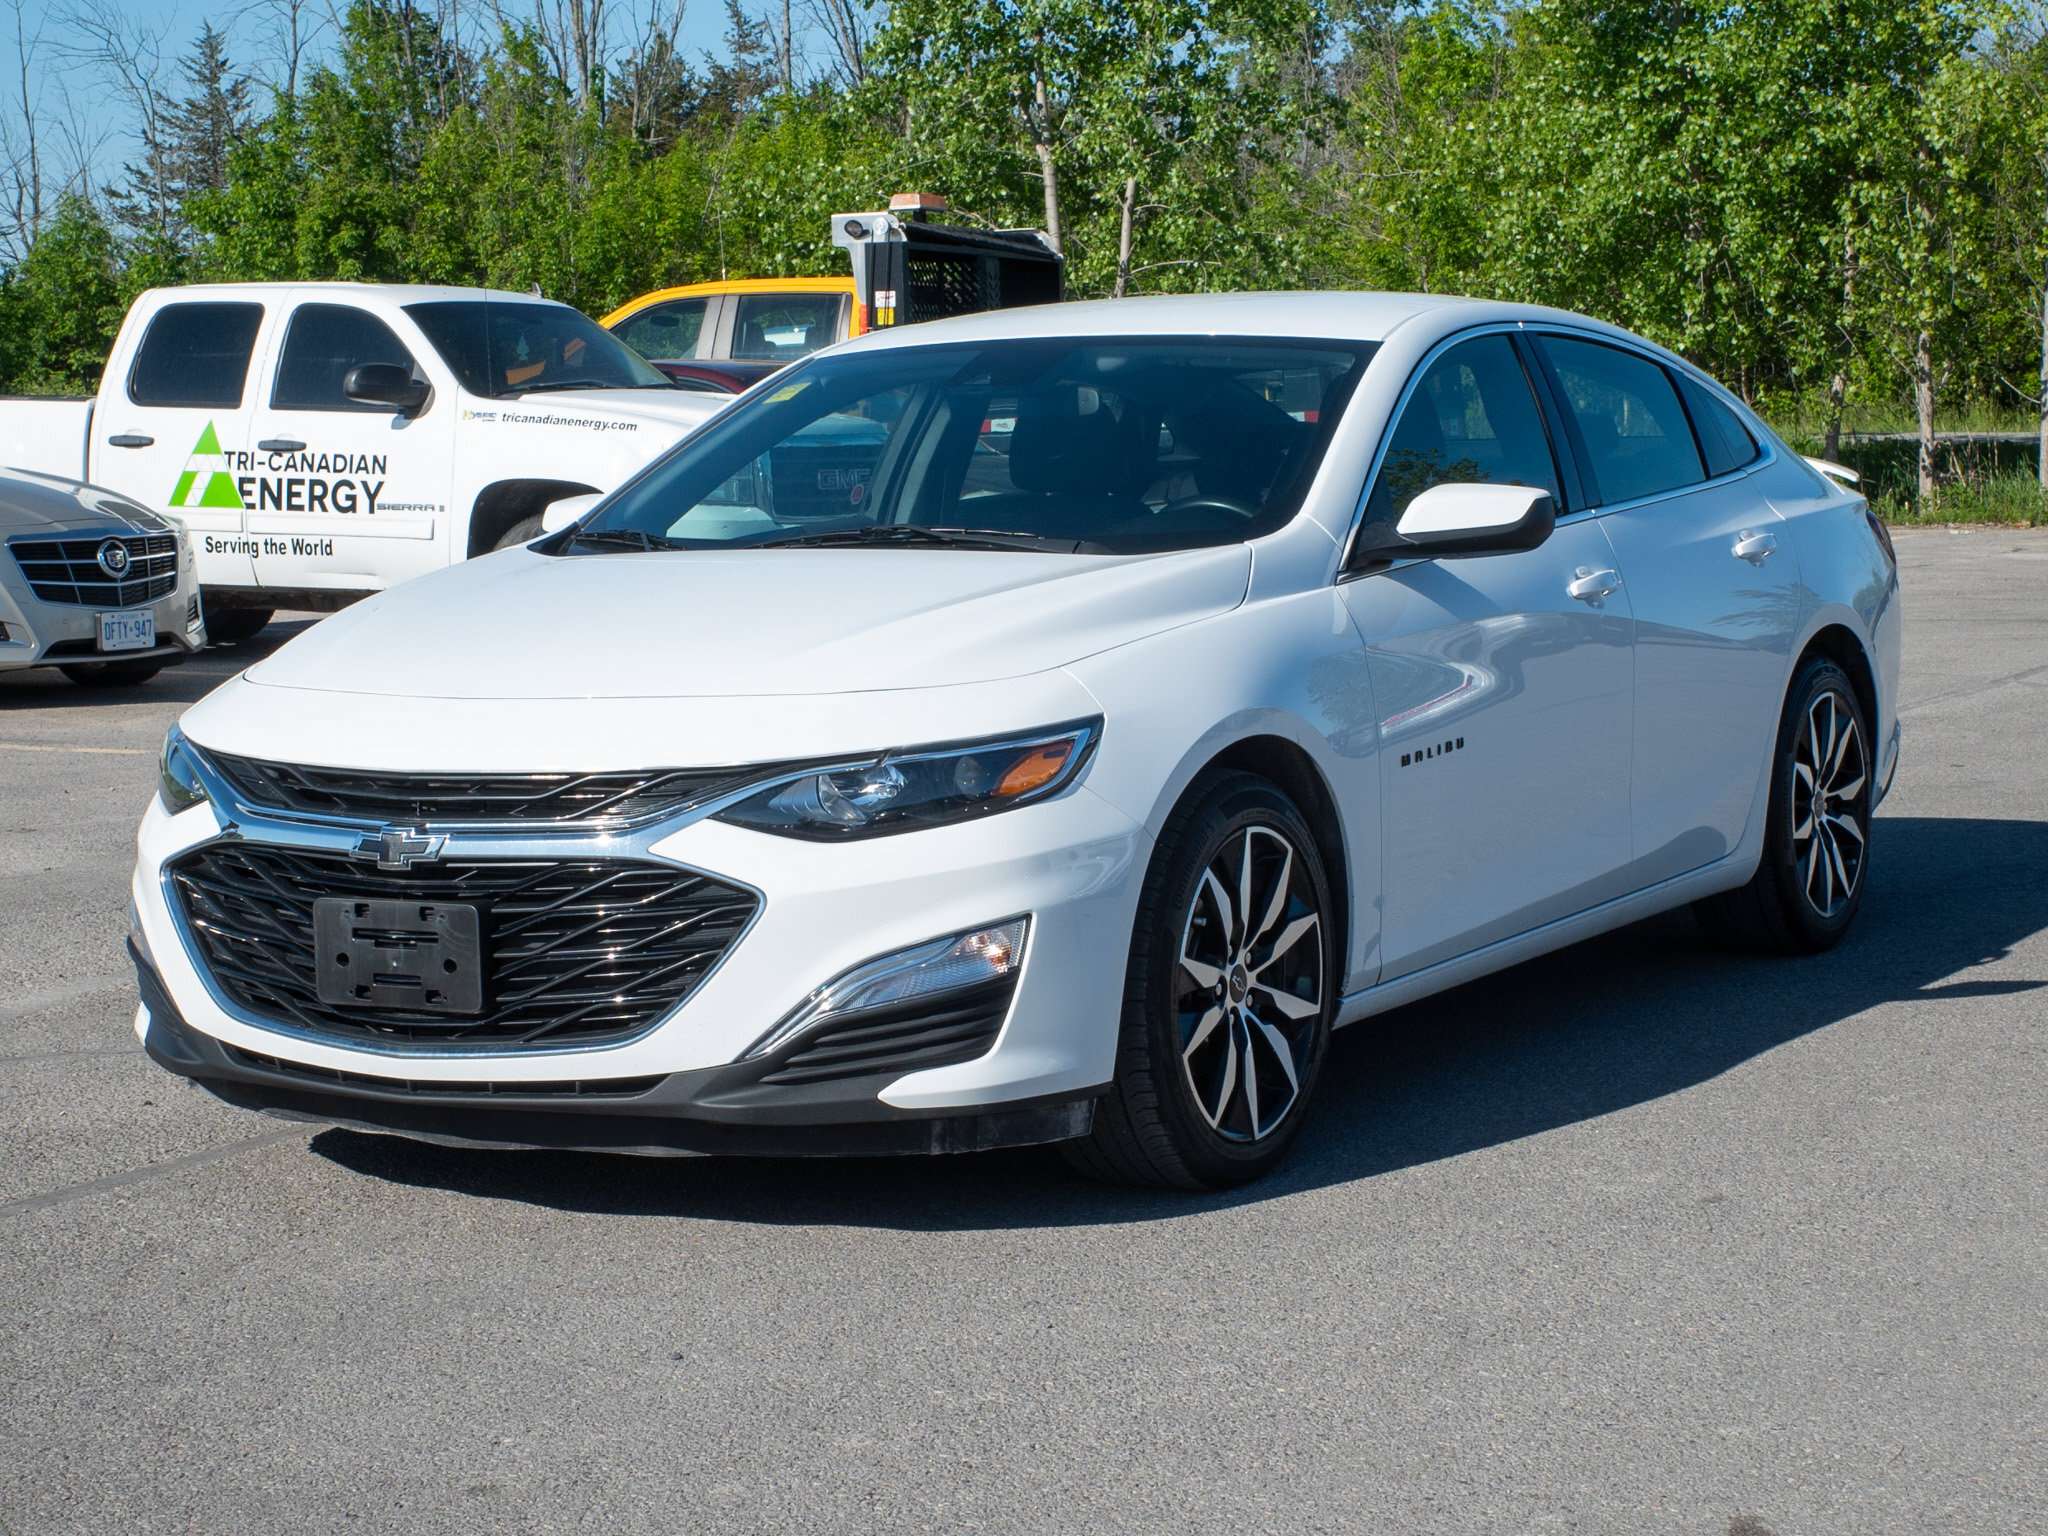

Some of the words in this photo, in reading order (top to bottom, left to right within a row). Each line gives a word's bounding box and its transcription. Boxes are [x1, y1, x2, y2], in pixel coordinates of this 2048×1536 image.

[502, 412, 638, 431] tricanadianenergy.com
[224, 451, 387, 475] TRI-CANADIAN
[238, 476, 385, 514] ENERGY
[377, 502, 436, 512] SIERRA
[205, 536, 259, 558] Serving
[264, 537, 287, 554] the
[291, 538, 333, 556] World
[1401, 737, 1465, 768] MALIBU
